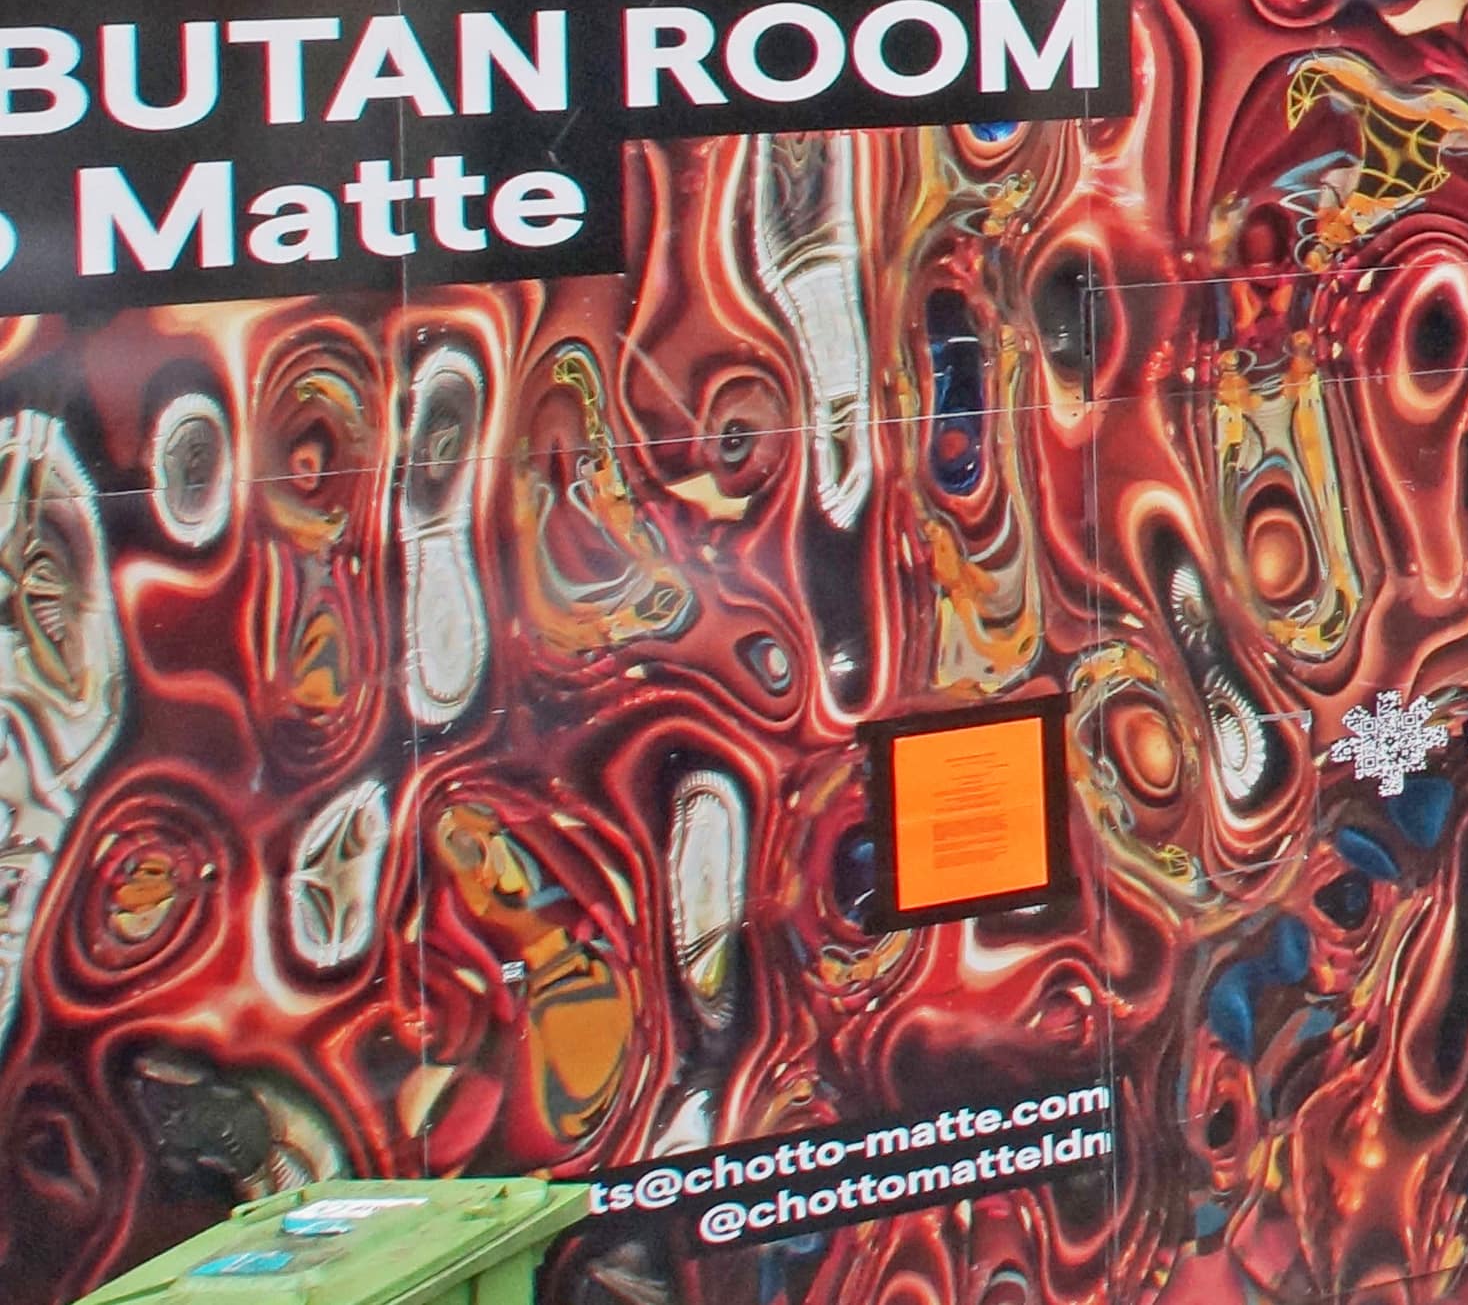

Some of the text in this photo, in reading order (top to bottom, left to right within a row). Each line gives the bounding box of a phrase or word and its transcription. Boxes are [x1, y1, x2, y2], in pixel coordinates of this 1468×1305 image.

[0, 8, 569, 137] BUTAN
[74, 154, 588, 276] Matte
[698, 1127, 1112, 1244] @chottomatteldn
